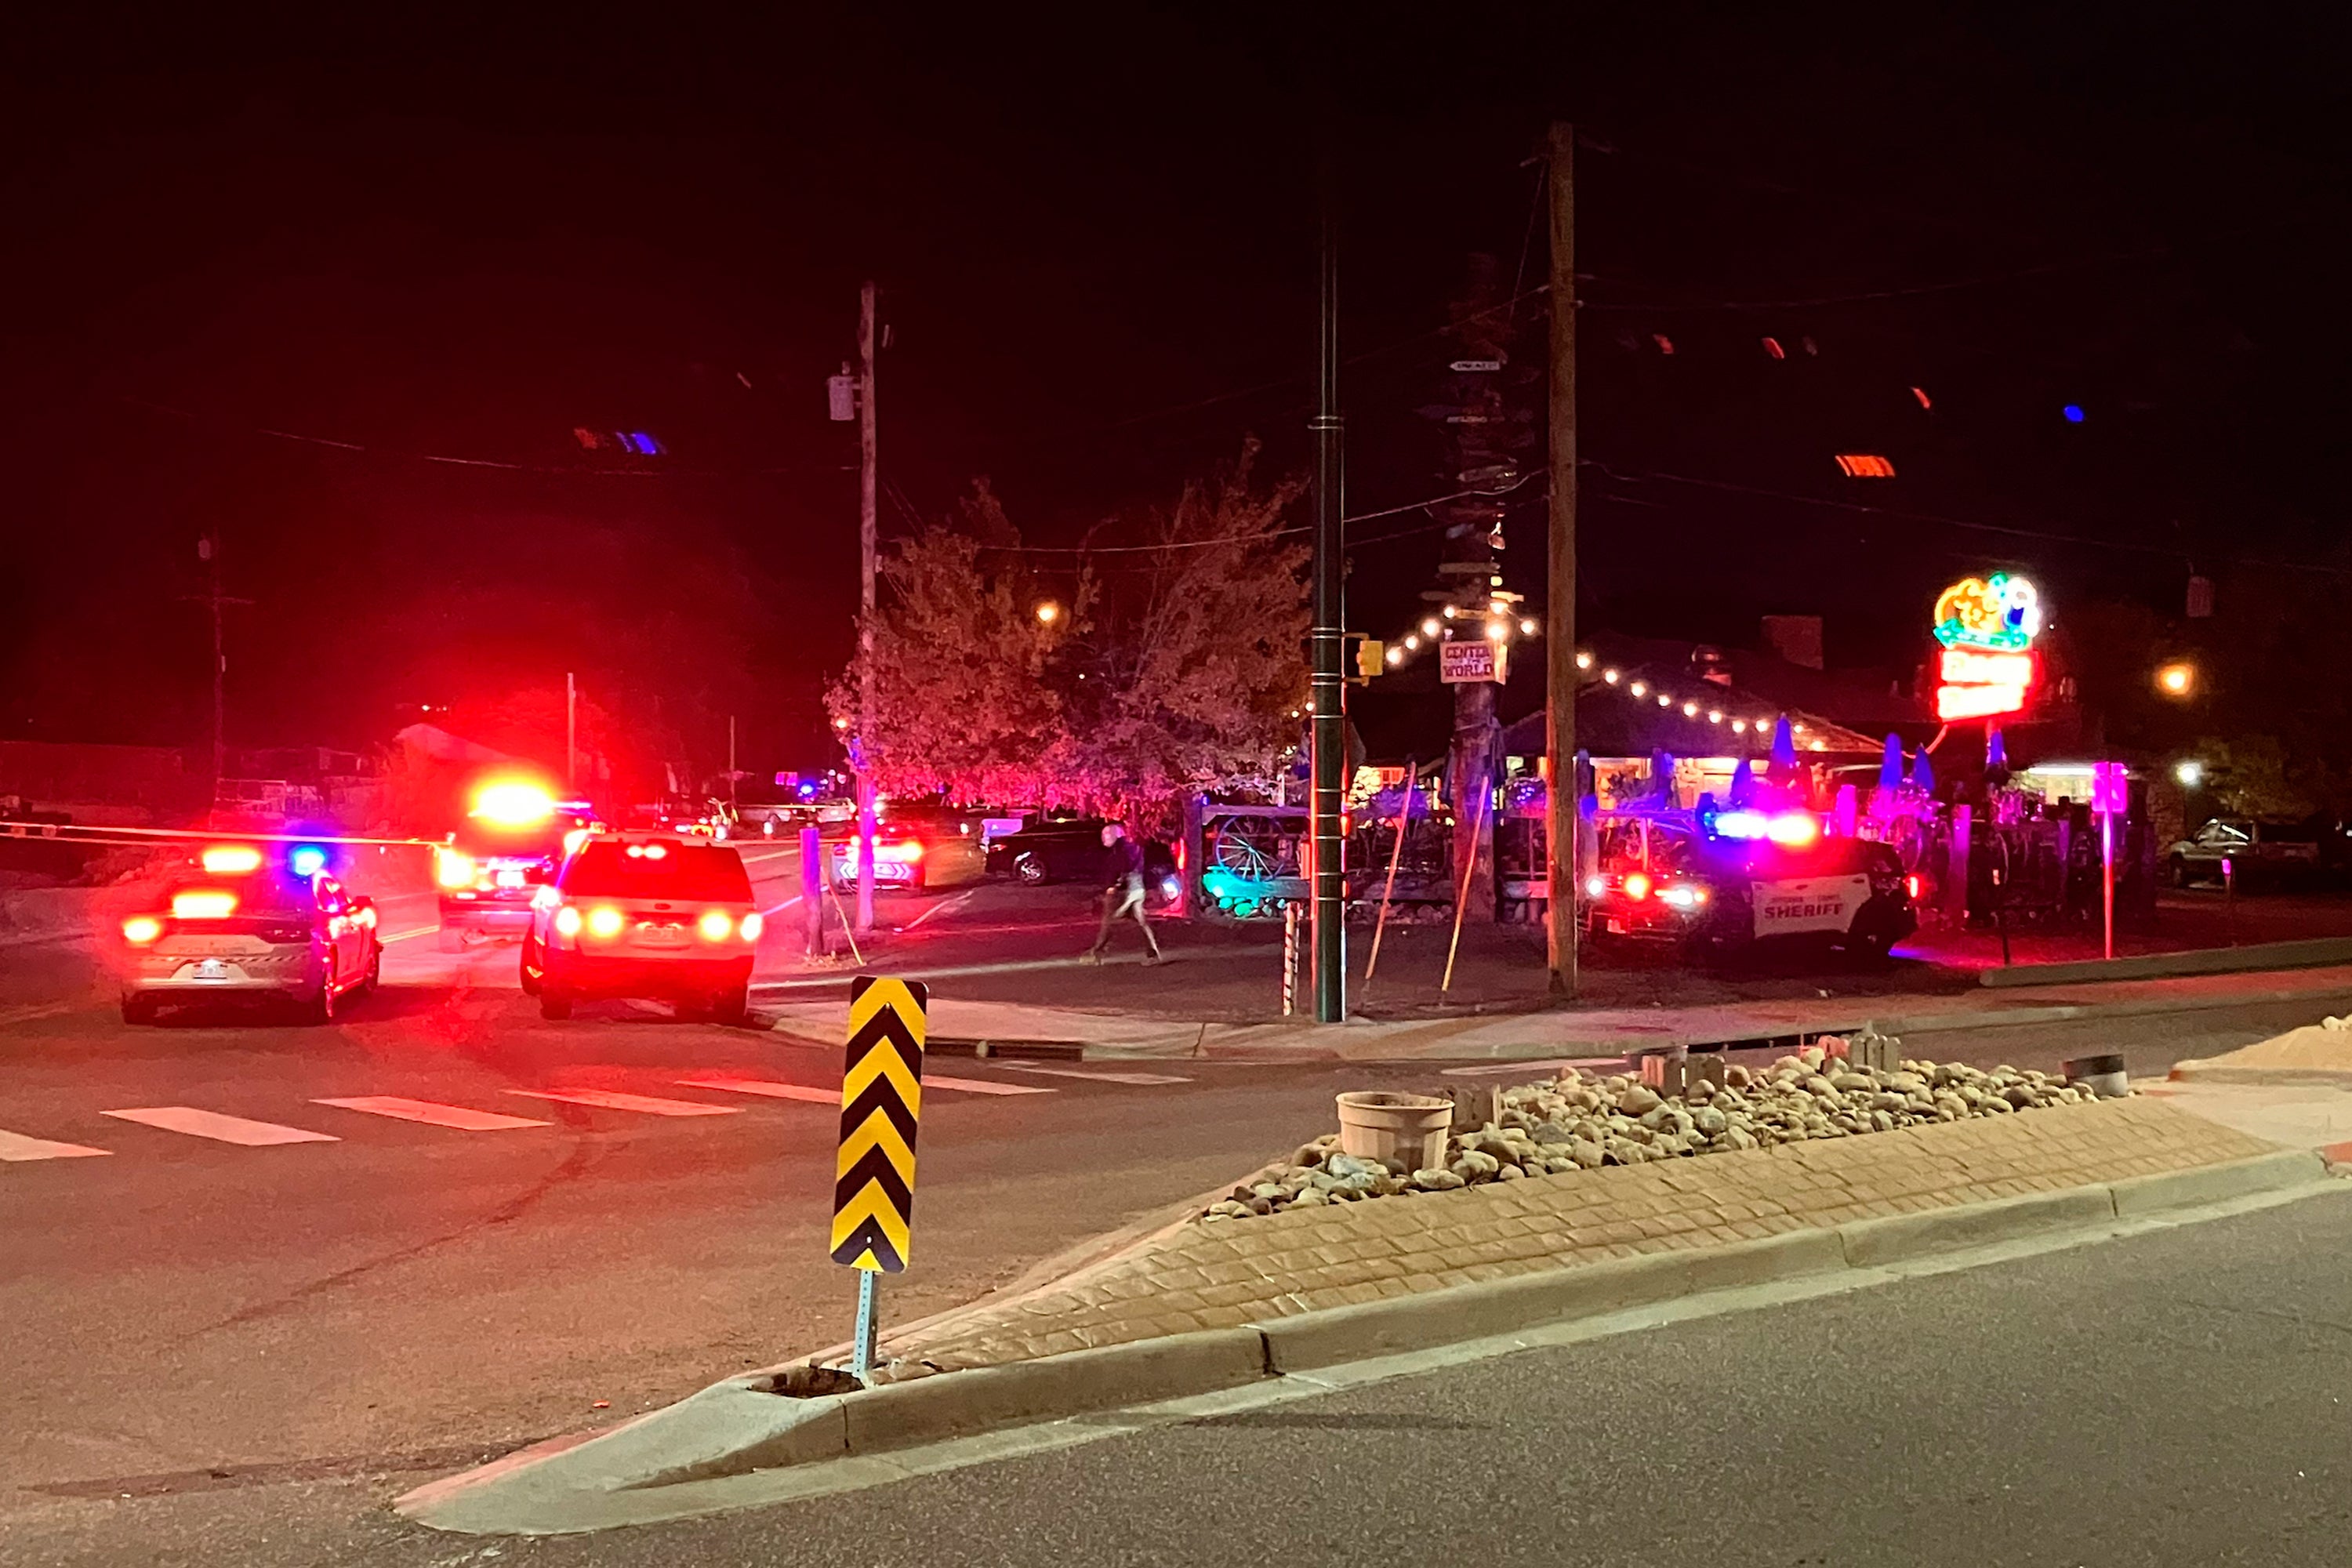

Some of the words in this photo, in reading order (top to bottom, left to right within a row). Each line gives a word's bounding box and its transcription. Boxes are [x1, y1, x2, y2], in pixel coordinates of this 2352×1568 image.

[1446, 646, 1490, 659] CENTER
[1443, 663, 1494, 677] WORLD
[1764, 903, 1844, 919] SHERIFF
